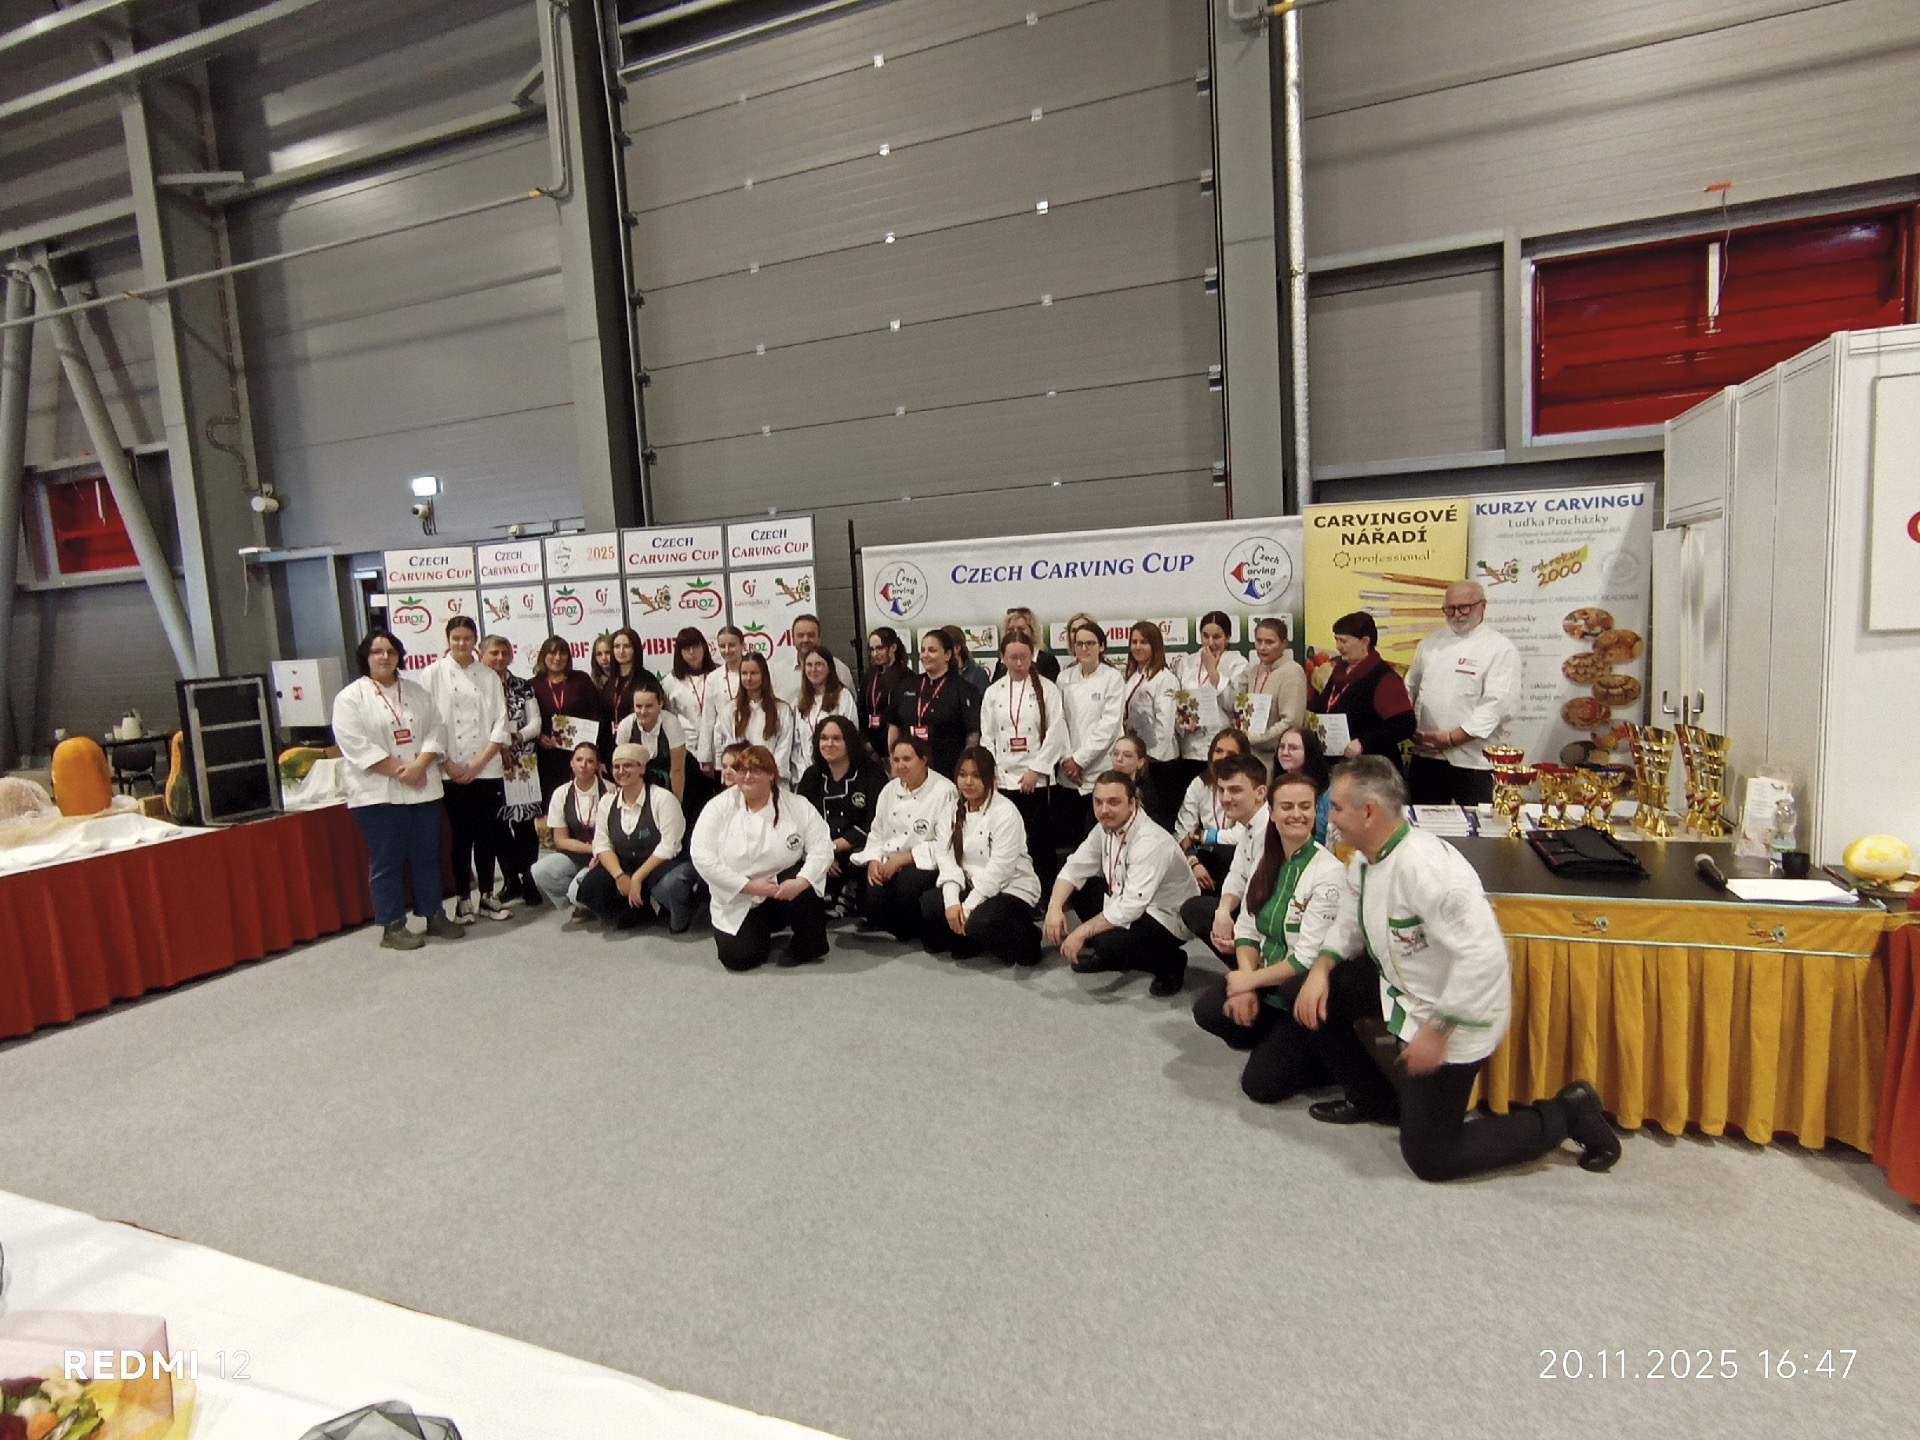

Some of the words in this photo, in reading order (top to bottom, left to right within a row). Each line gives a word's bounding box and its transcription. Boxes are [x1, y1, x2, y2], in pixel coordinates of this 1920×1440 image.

[1476, 500, 1537, 516] KURZY
[1544, 493, 1645, 512] CARVINGU
[1313, 504, 1458, 528] CARVINGOVÉ
[1548, 514, 1609, 527] Procházky
[751, 528, 788, 541] CZECH
[1341, 525, 1428, 546] NÁŘADÍ
[652, 537, 694, 549] CZECH
[731, 545, 781, 559] CARVING
[784, 541, 809, 554] CUP
[494, 550, 523, 562] CZECH
[586, 546, 615, 561] 2025
[628, 553, 687, 565] CARVING
[691, 549, 719, 561] CUP
[1252, 545, 1279, 566] Czech
[1353, 550, 1430, 565] professional
[409, 556, 449, 567] CZECH
[951, 564, 1023, 585] CZECH
[1030, 558, 1134, 580] CARVING
[1142, 552, 1195, 573] CUP
[389, 570, 443, 582] CARVING
[446, 568, 472, 579] CUP
[481, 564, 519, 577] CARVING
[520, 562, 539, 574] CUP
[1537, 561, 1582, 587] 2000
